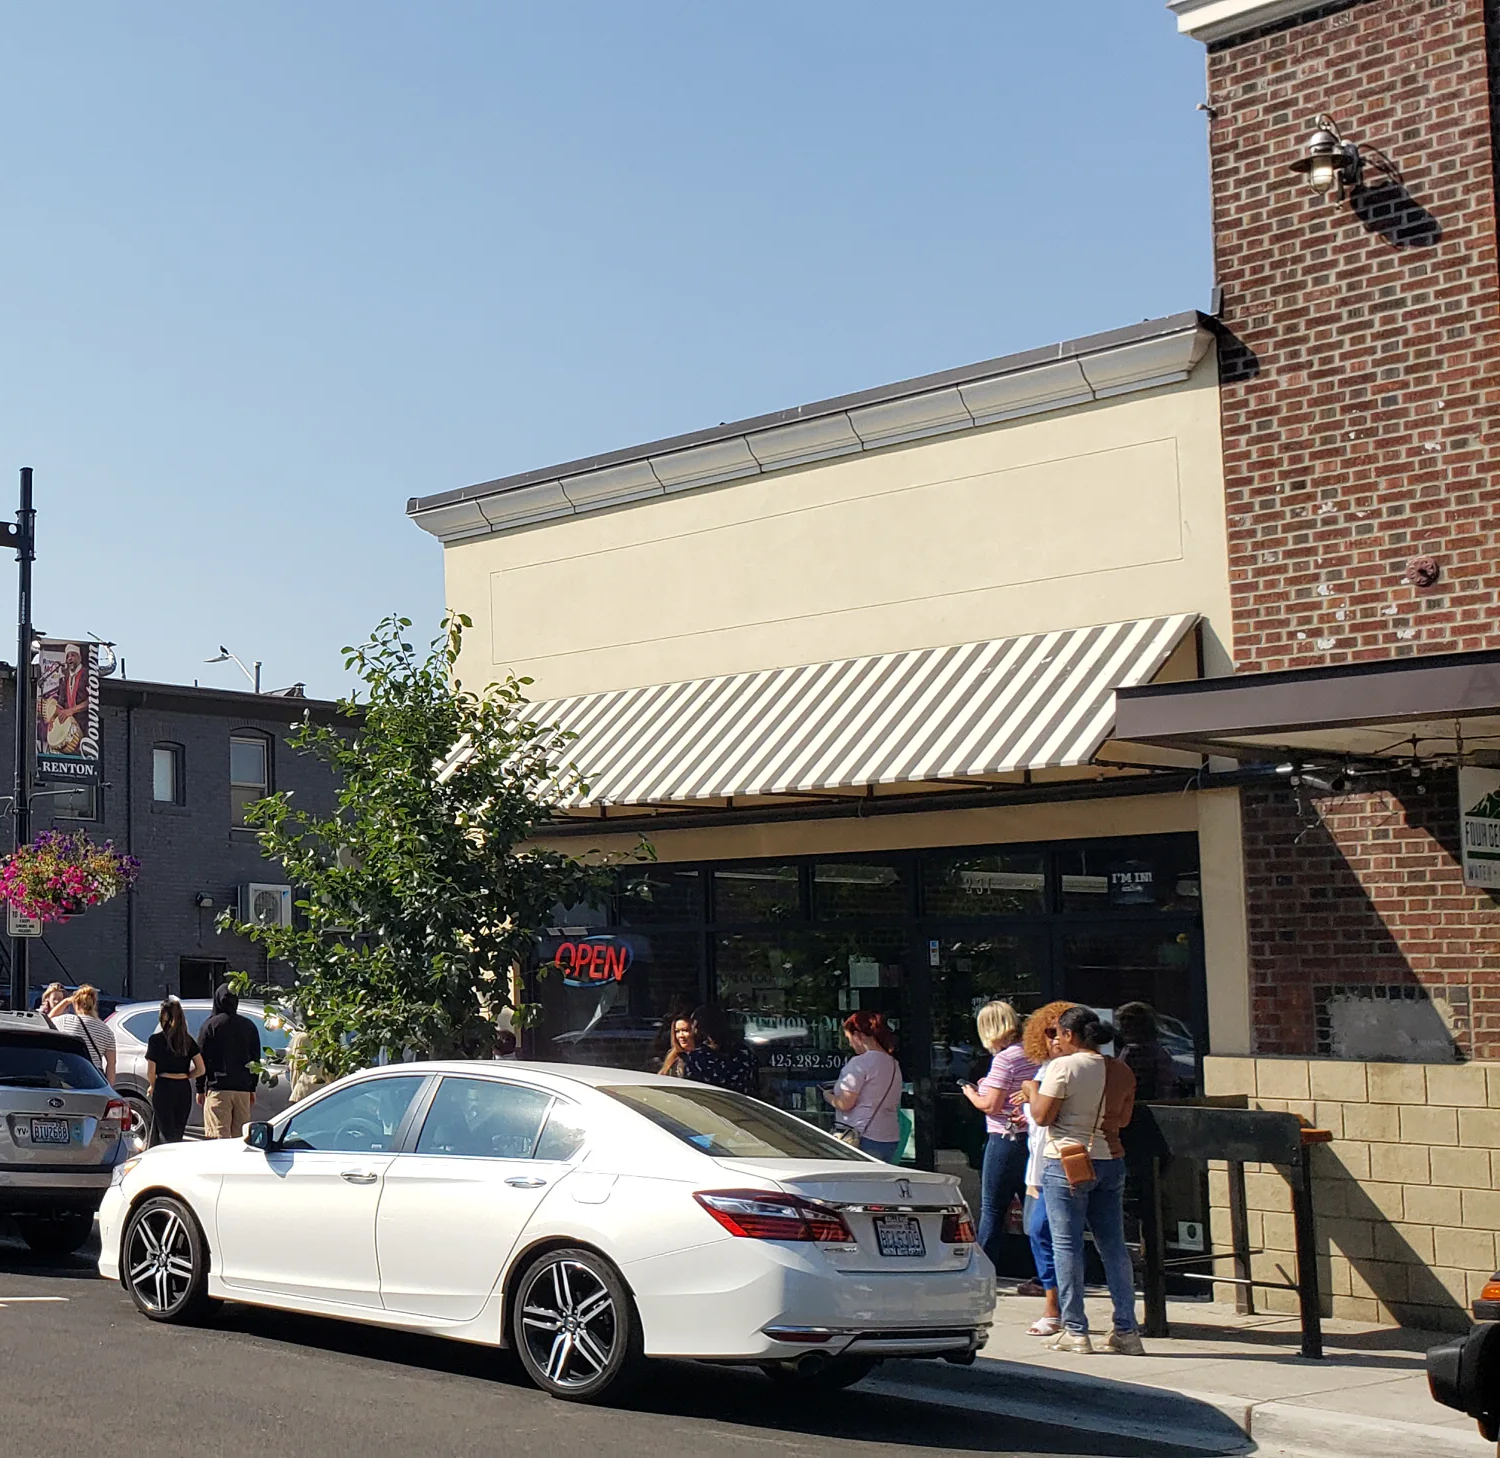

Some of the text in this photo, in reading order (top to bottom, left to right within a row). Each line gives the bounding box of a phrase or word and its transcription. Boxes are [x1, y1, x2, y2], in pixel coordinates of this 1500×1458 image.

[80, 644, 99, 761] Downtown
[1466, 821, 1500, 848] FOUR GE
[555, 942, 626, 980] OPEN
[768, 1053, 848, 1069] 425.282.504
